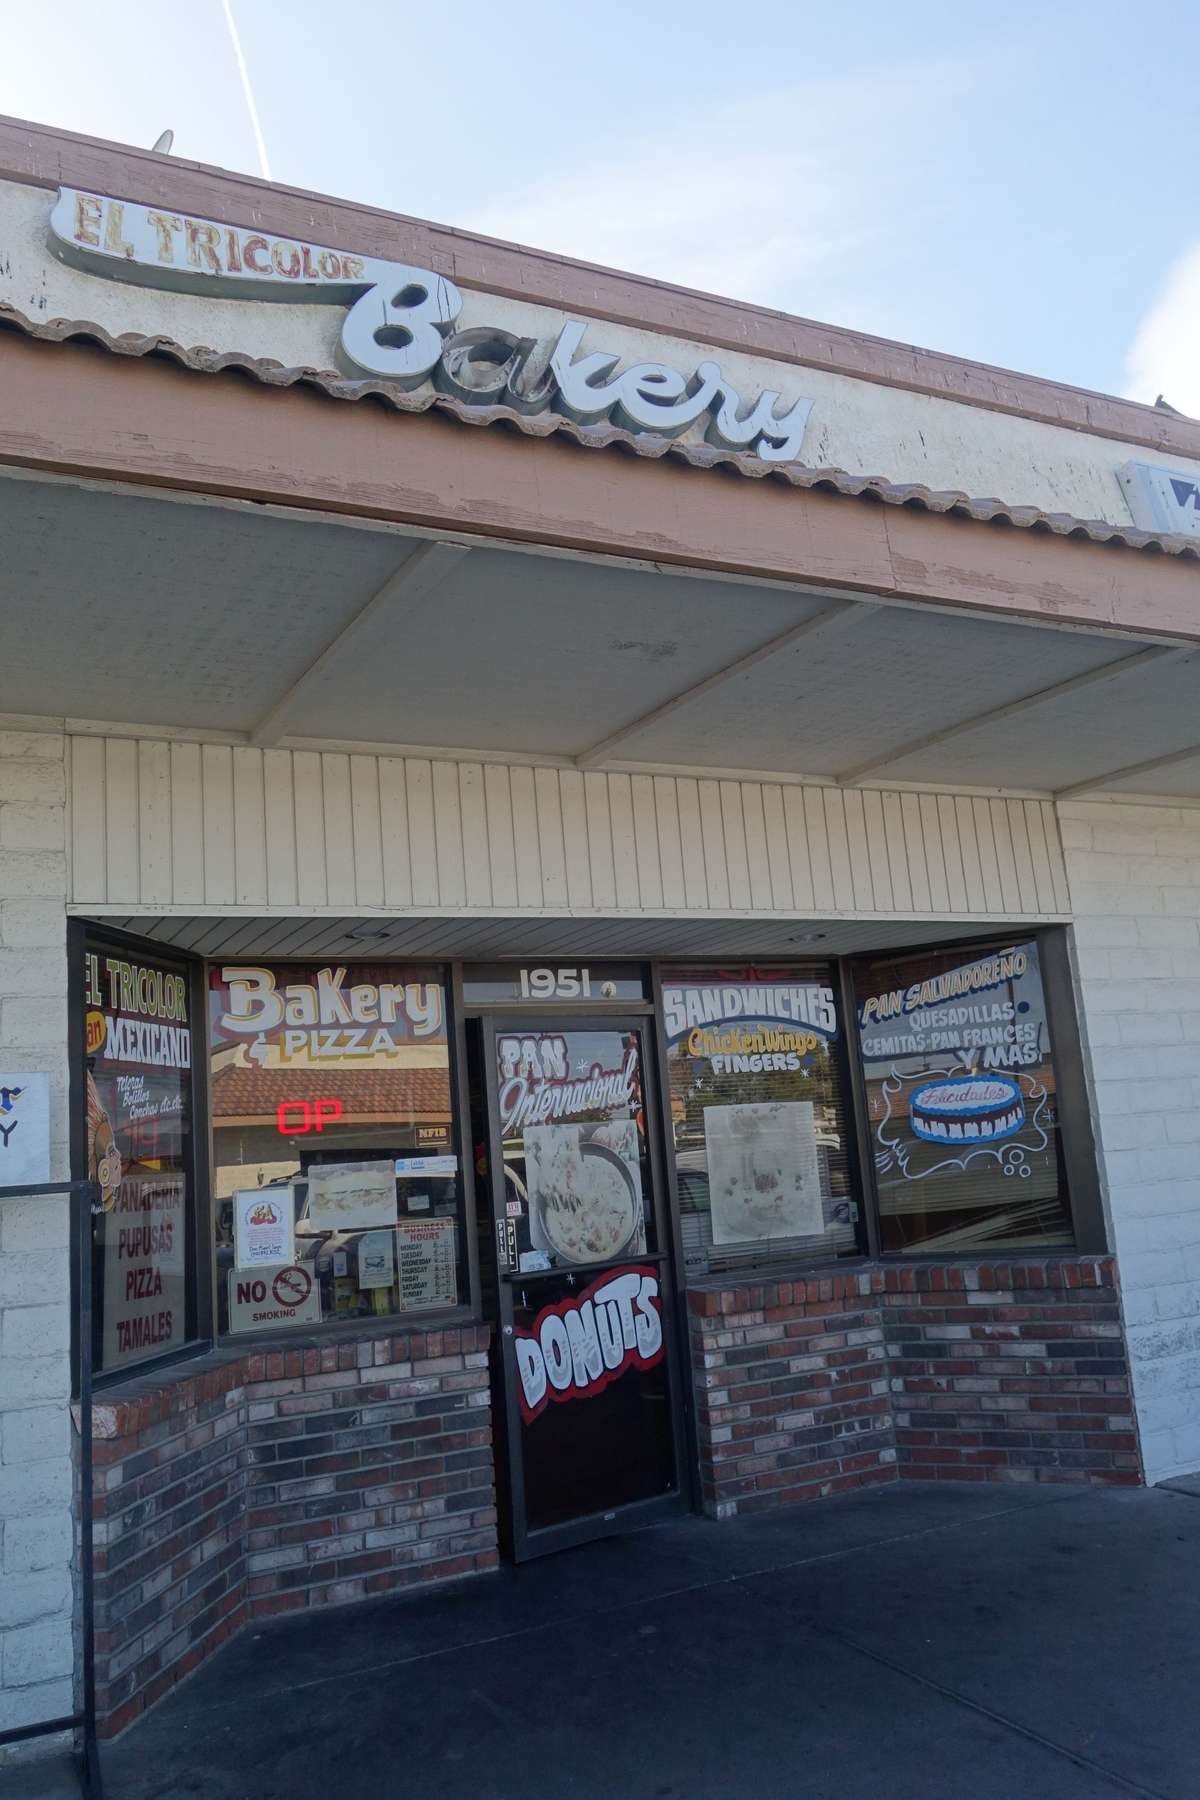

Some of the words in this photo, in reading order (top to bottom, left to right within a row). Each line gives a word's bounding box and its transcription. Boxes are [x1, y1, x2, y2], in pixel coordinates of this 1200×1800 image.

[74, 193, 134, 257] EL
[148, 209, 366, 281] TRICOLOR
[340, 263, 815, 462] Bakery
[106, 959, 187, 1022] TRICOLOR
[520, 968, 591, 998] 1951
[663, 987, 837, 1039] SANDWICHES
[861, 990, 903, 1025] PAN
[909, 1001, 1015, 1032] QUESADILLAS
[87, 1019, 101, 1047] an
[104, 1016, 191, 1068] MEXICANO
[283, 1028, 396, 1060] PIZZA
[757, 1024, 817, 1055] Wings
[964, 1023, 1036, 1047] FRANCES
[500, 1038, 568, 1078] PAN
[711, 1053, 800, 1075] FINGERS
[278, 1099, 342, 1134] OP
[118, 1223, 173, 1259] PUPUSAS
[410, 1232, 440, 1242] HOURS
[507, 1226, 515, 1265] PULL
[126, 1268, 162, 1301] PIZZA
[237, 1280, 266, 1304] NO
[117, 1311, 172, 1352] TAMALES
[252, 1308, 296, 1321] SMOKING
[515, 1273, 662, 1409] DONUTS
